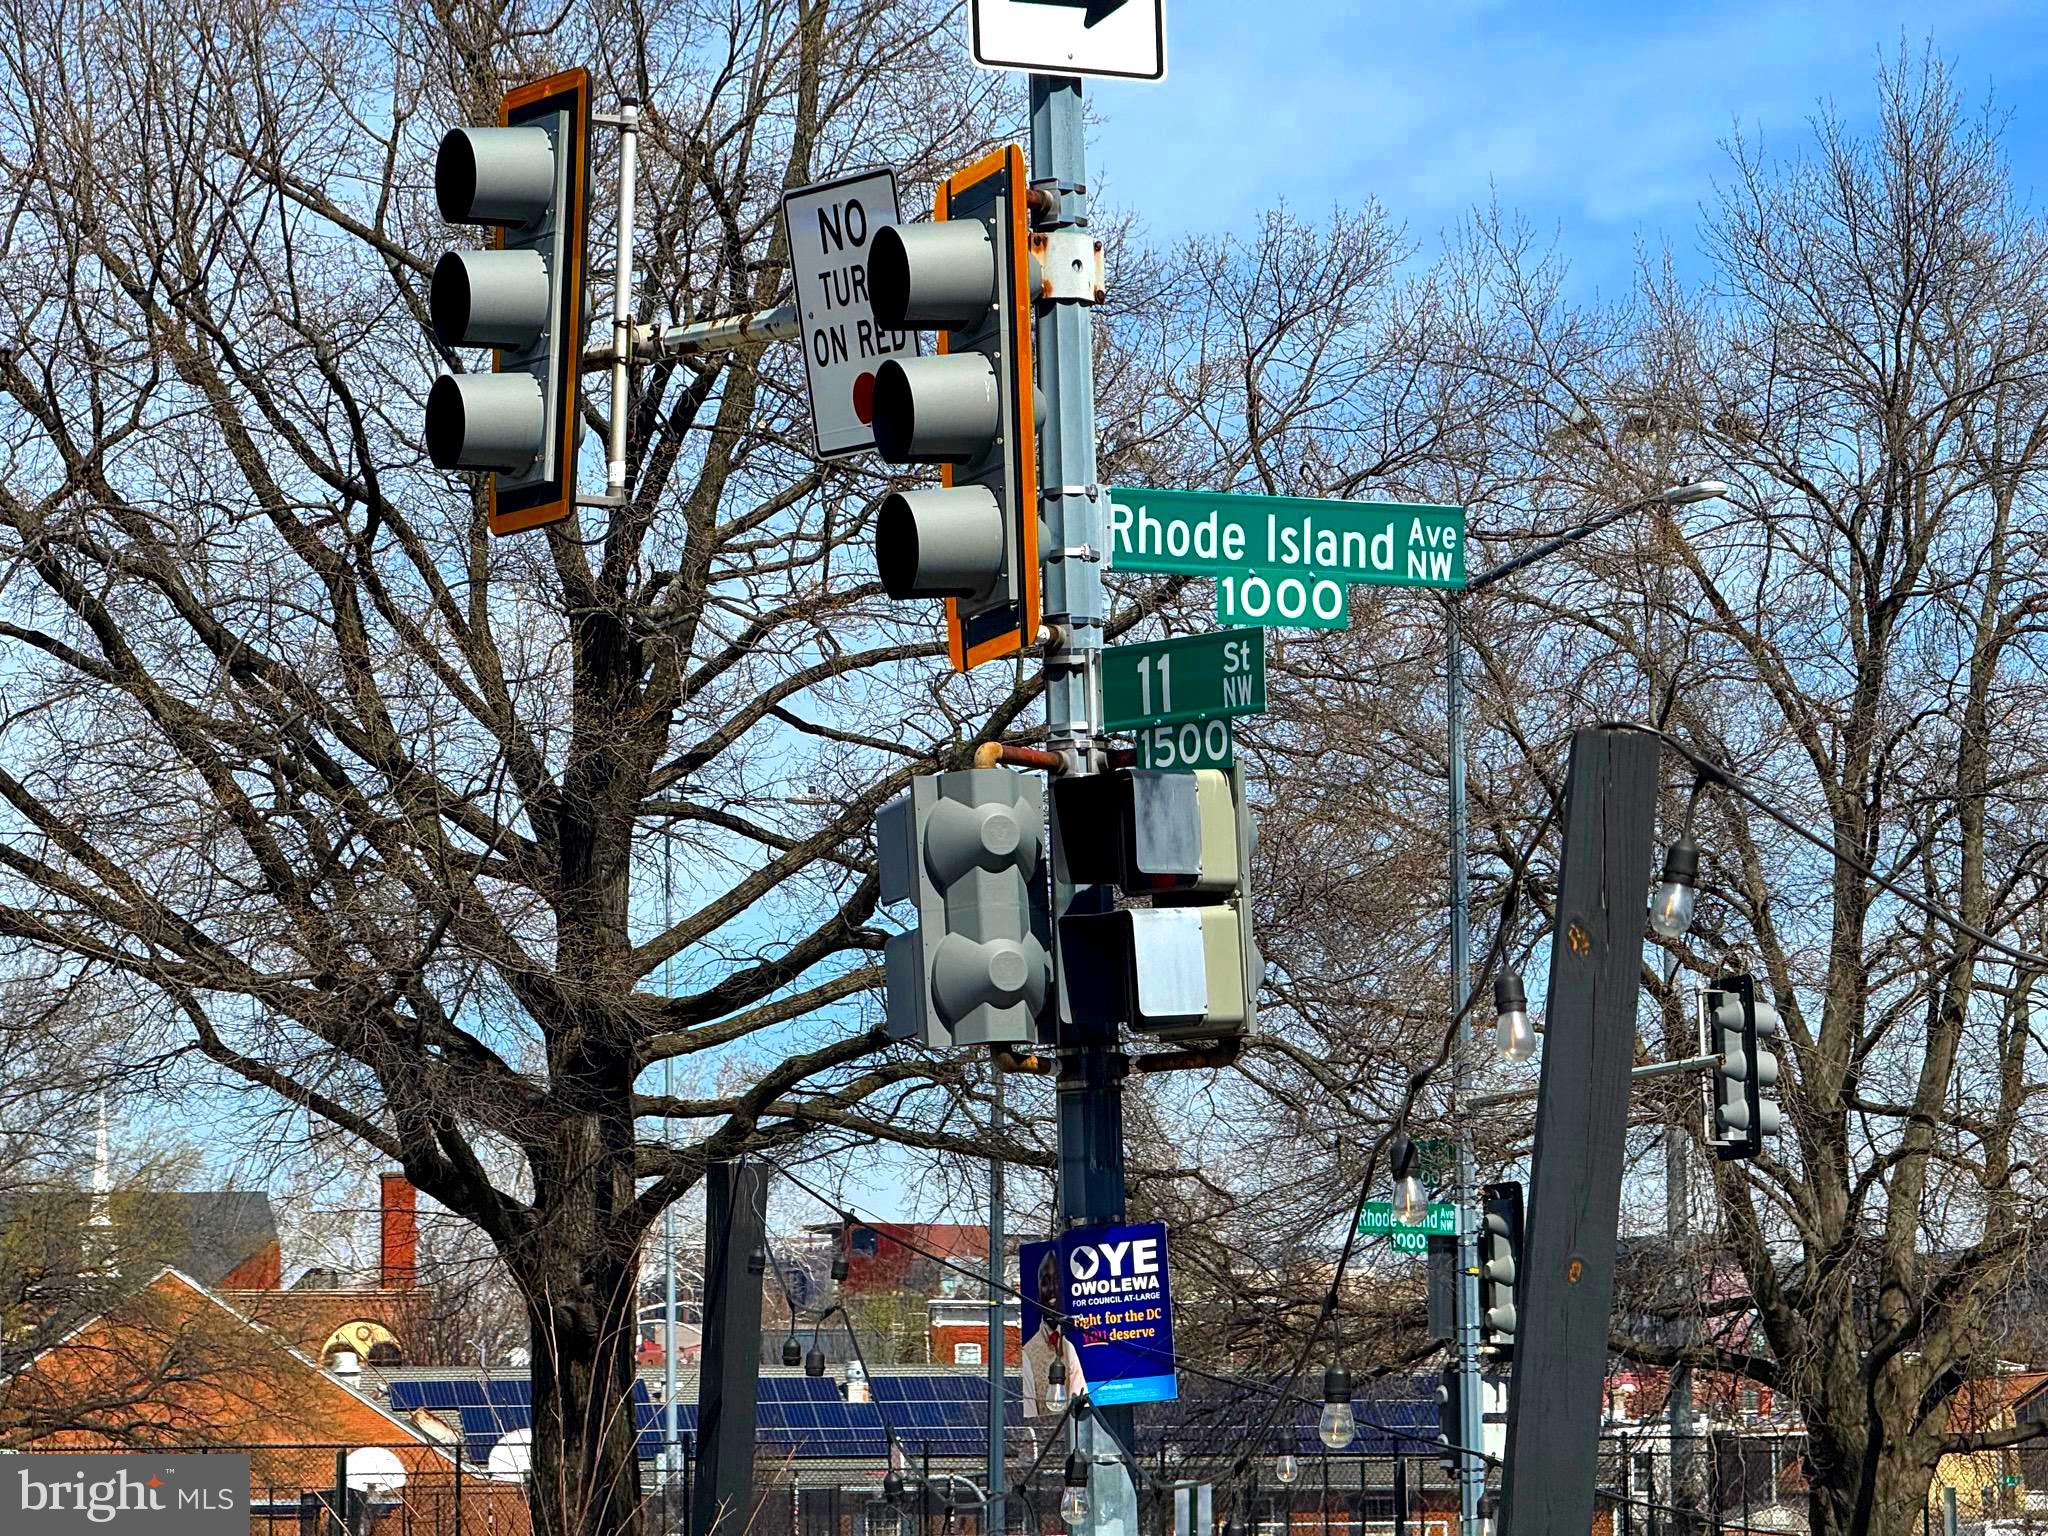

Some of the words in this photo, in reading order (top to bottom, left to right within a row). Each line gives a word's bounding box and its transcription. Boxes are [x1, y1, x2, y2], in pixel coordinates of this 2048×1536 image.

[817, 199, 867, 254] NO
[818, 264, 870, 310] TUR
[813, 324, 849, 367] ON
[1111, 503, 1246, 561] Rhode
[1267, 514, 1394, 571] Island
[1408, 517, 1457, 550] Ave
[1407, 549, 1453, 582] NW
[1221, 576, 1343, 620] 1000
[1223, 640, 1250, 673] St
[1137, 653, 1172, 716] 11
[1223, 674, 1253, 708] NW
[1141, 719, 1228, 769] 1500
[1359, 1208, 1398, 1228] Rhode
[1440, 1207, 1455, 1219] Ave
[1440, 1219, 1454, 1231] NW
[1391, 1232, 1426, 1249] 1000
[1069, 1238, 1159, 1280] OYE
[1071, 1274, 1160, 1297] OWOLEWA
[1072, 1298, 1087, 1307] FOR
[1088, 1295, 1122, 1306] COUNCIL
[1123, 1291, 1161, 1303] AT-LARGE
[1105, 1311, 1123, 1324] for
[1125, 1309, 1144, 1322] the
[1146, 1307, 1162, 1320] DC
[1109, 1327, 1155, 1341] deserve
